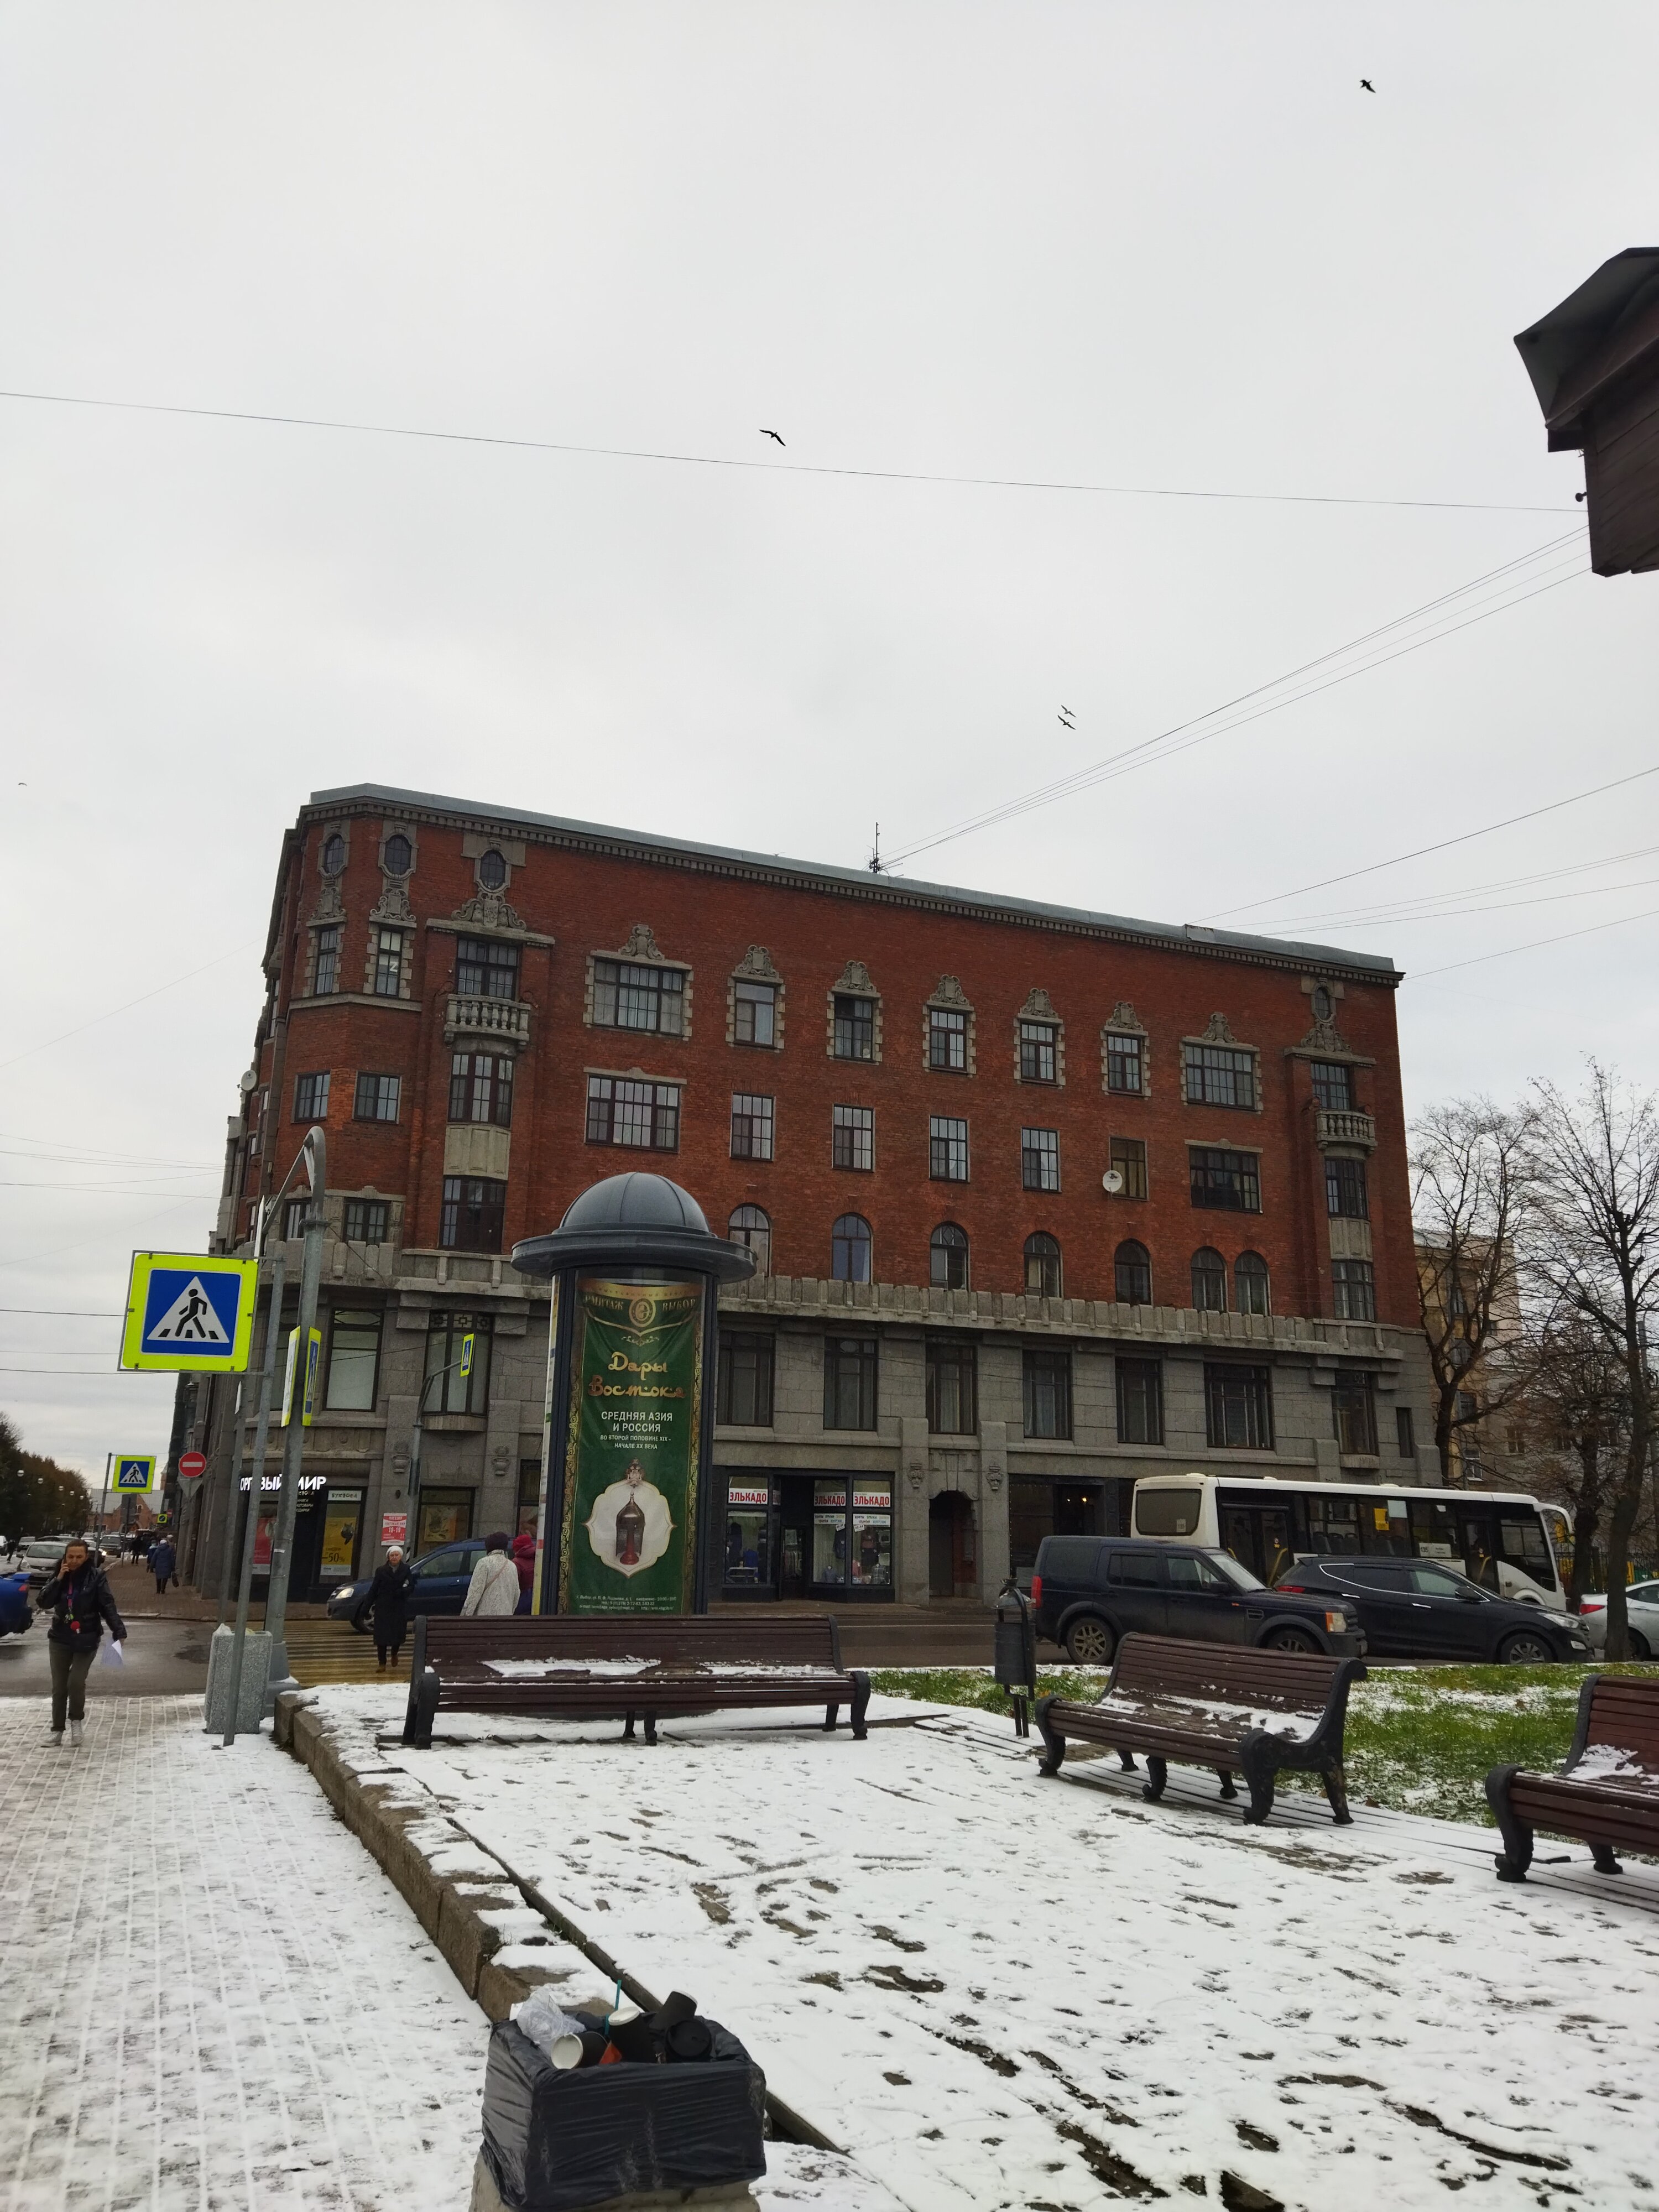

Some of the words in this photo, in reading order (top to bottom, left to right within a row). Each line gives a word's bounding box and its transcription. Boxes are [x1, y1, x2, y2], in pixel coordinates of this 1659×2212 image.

[584, 1295, 624, 1311] РМИТАЖ
[608, 1351, 668, 1381] Дары
[588, 1375, 686, 1399] Востока
[601, 1411, 646, 1422] СРЕДНЯЯ
[648, 1412, 673, 1421] АЗИЯ
[613, 1423, 619, 1432] И
[622, 1423, 661, 1432] РОССИЯ
[729, 1492, 767, 1504] ЭЛЬКАДО
[815, 1495, 845, 1506] ЭЛЬКАДО
[854, 1495, 889, 1507] ЭЛЬКАДО
